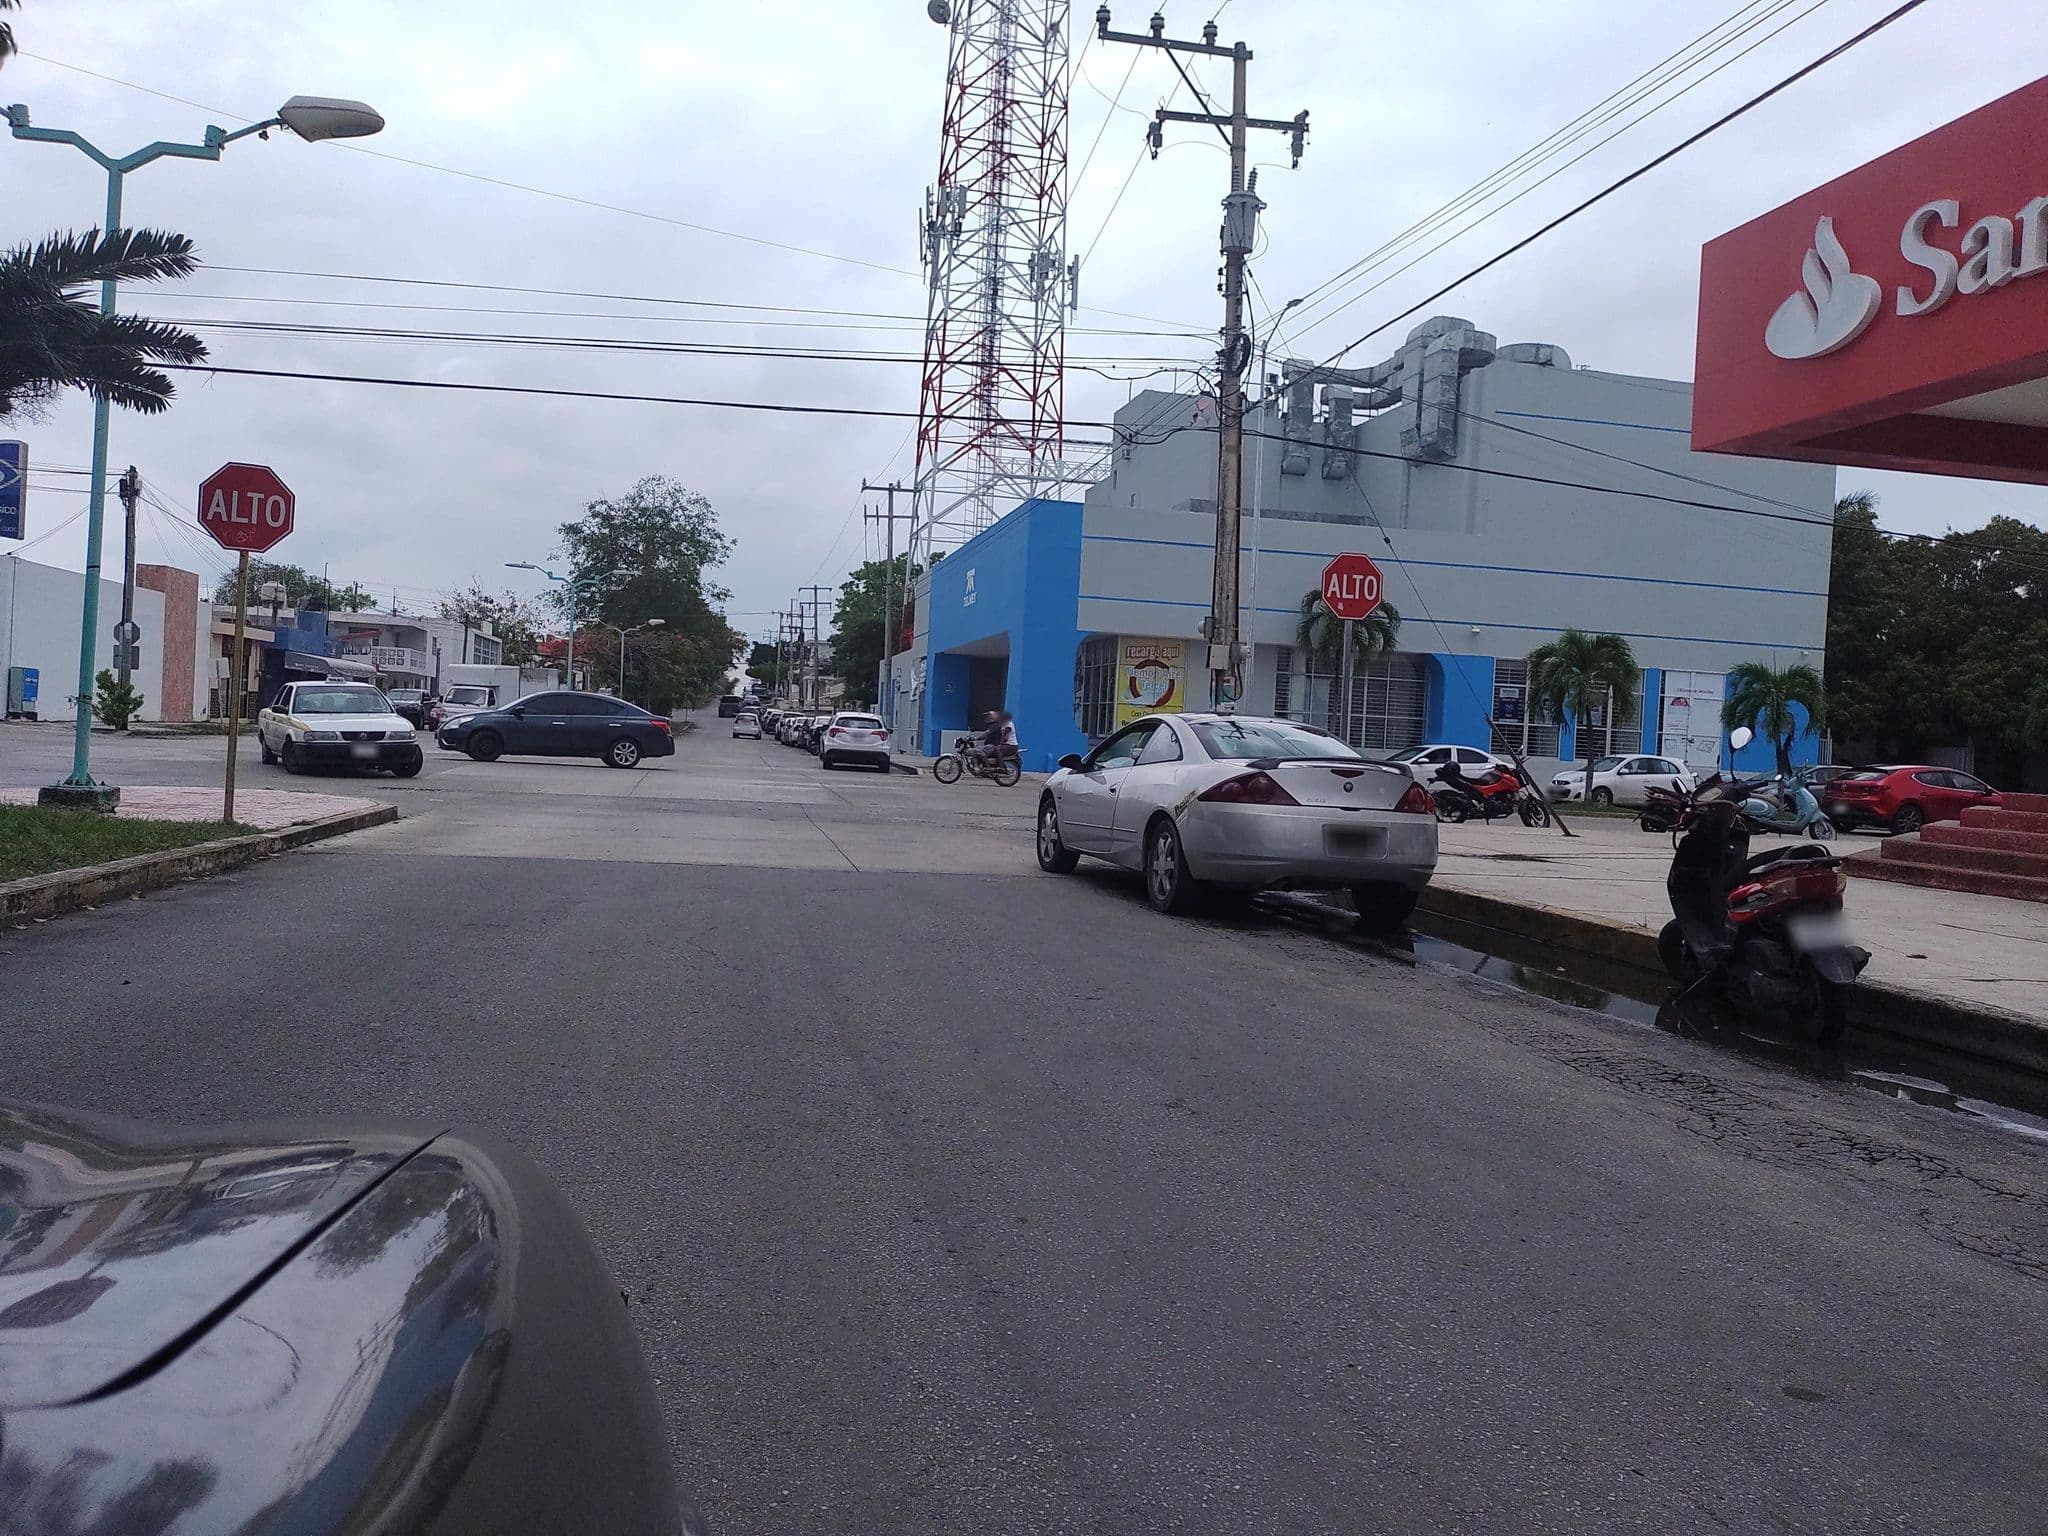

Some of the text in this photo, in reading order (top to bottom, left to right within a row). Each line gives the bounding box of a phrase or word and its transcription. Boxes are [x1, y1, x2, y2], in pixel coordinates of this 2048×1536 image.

[206, 488, 286, 528] ALTO
[1327, 573, 1378, 601] ALTO
[1126, 645, 1160, 660] recarga
